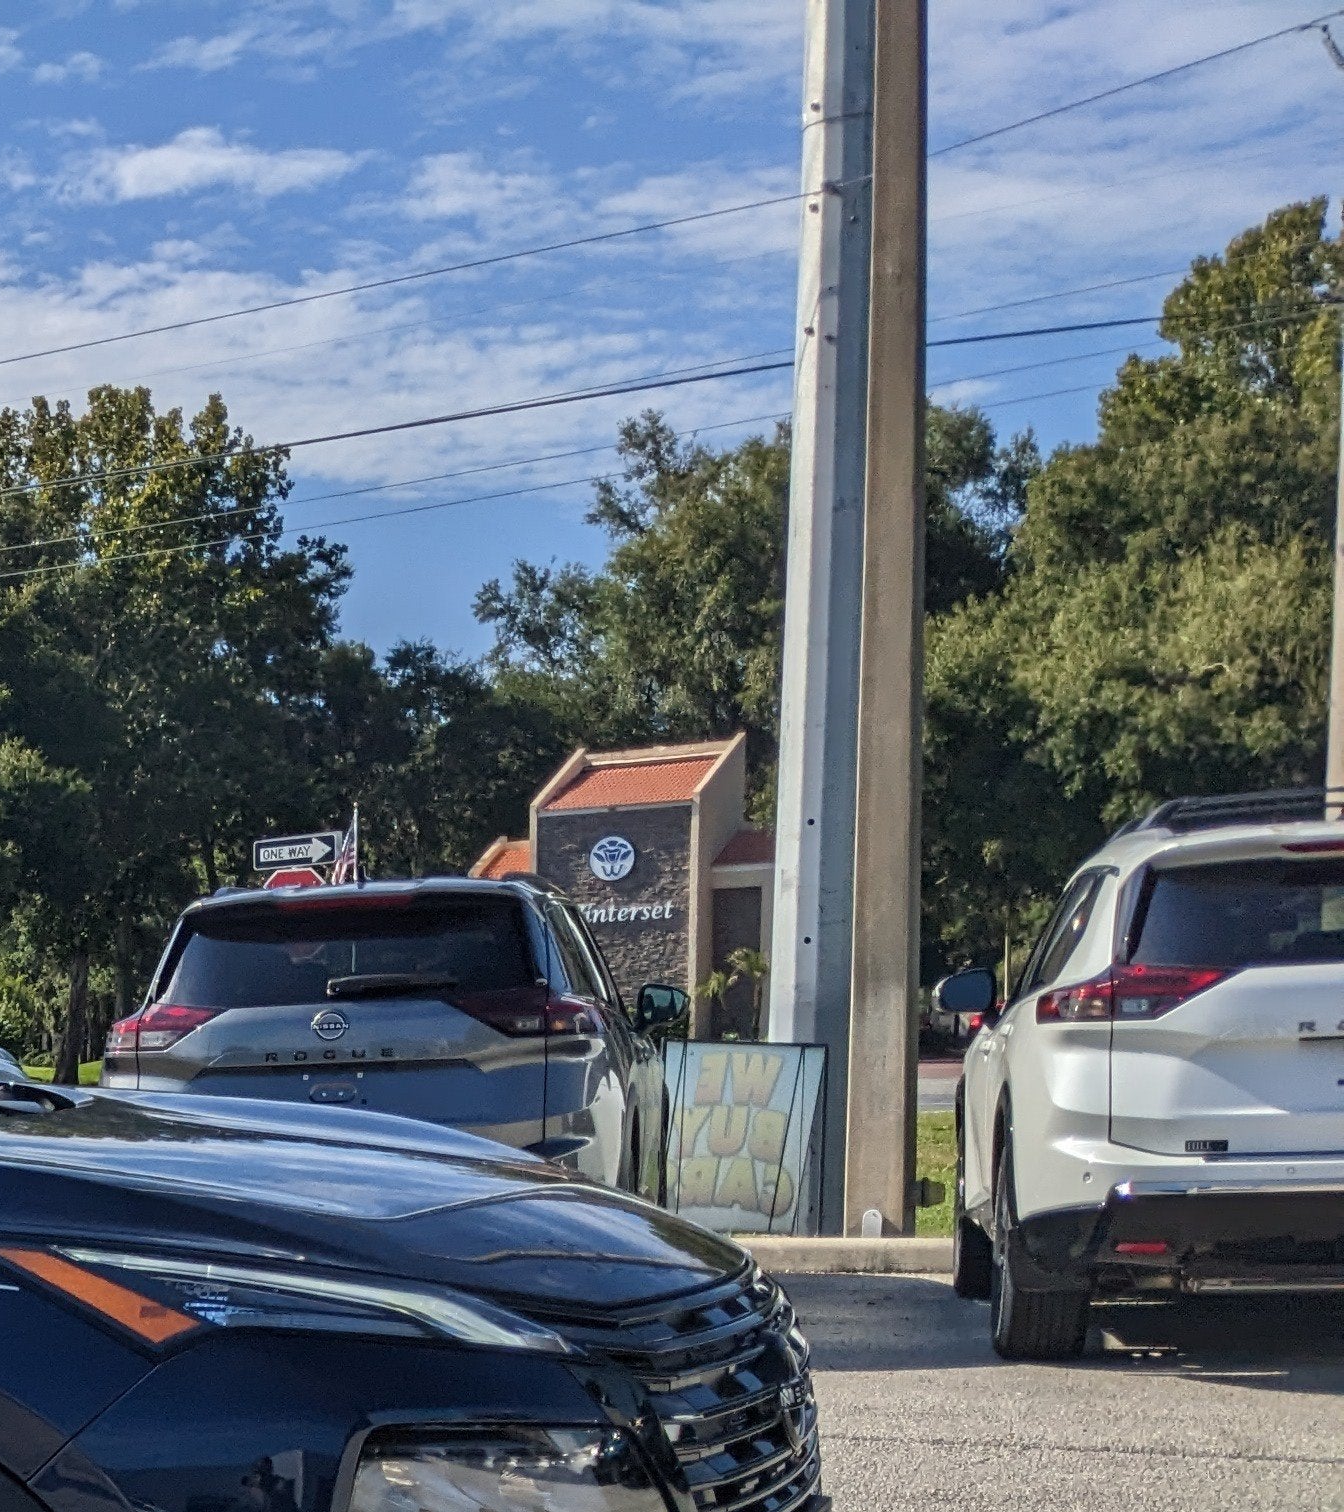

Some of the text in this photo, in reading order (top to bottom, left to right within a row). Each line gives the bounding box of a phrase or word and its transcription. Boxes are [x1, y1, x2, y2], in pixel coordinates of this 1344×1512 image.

[262, 845, 311, 861] ONE WAY
[312, 1022, 349, 1030] NISSAN
[265, 1048, 394, 1063] ROGUE
